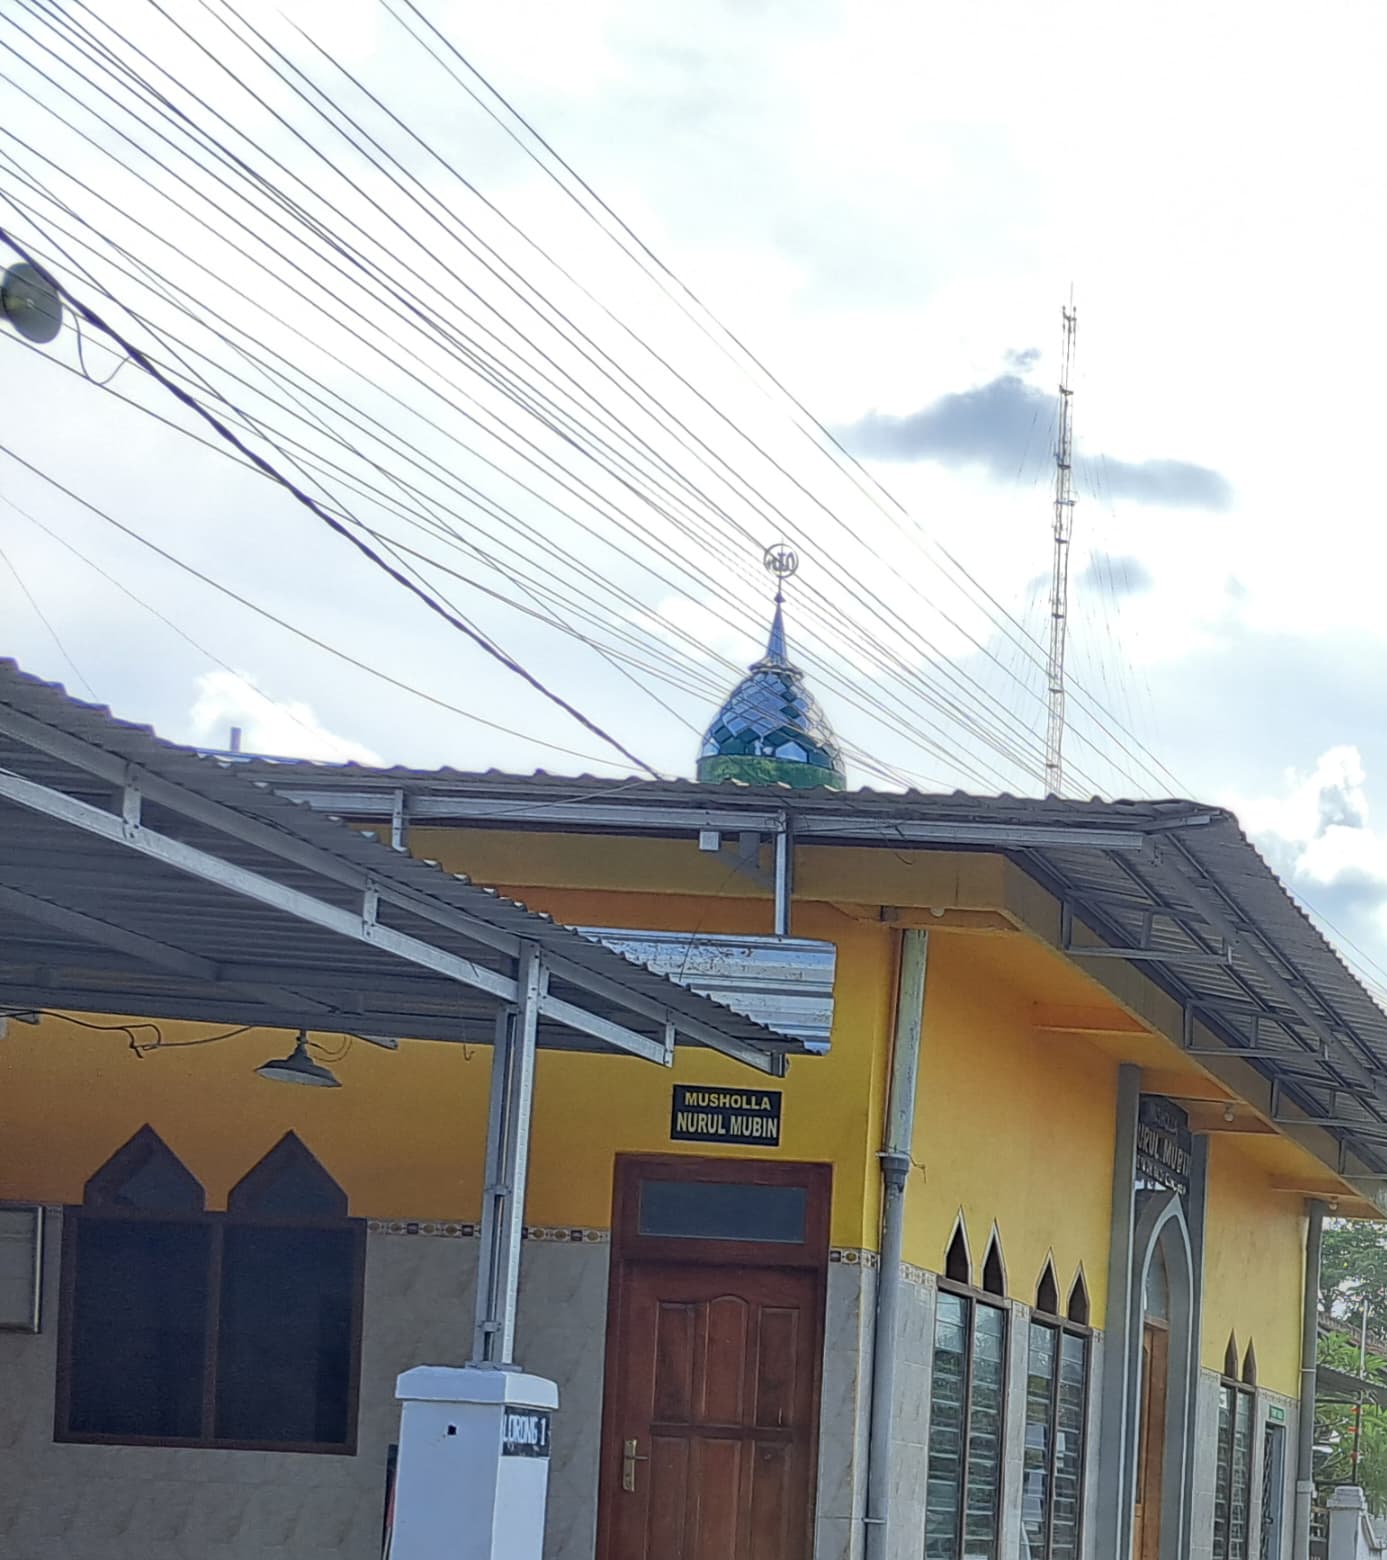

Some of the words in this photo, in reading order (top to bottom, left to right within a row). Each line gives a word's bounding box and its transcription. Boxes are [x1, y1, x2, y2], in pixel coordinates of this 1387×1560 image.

[685, 1091, 771, 1111] MUSHOLLA
[676, 1111, 726, 1135] NURUL
[729, 1115, 778, 1138] MUBIN
[503, 1414, 538, 1444] LORONG
